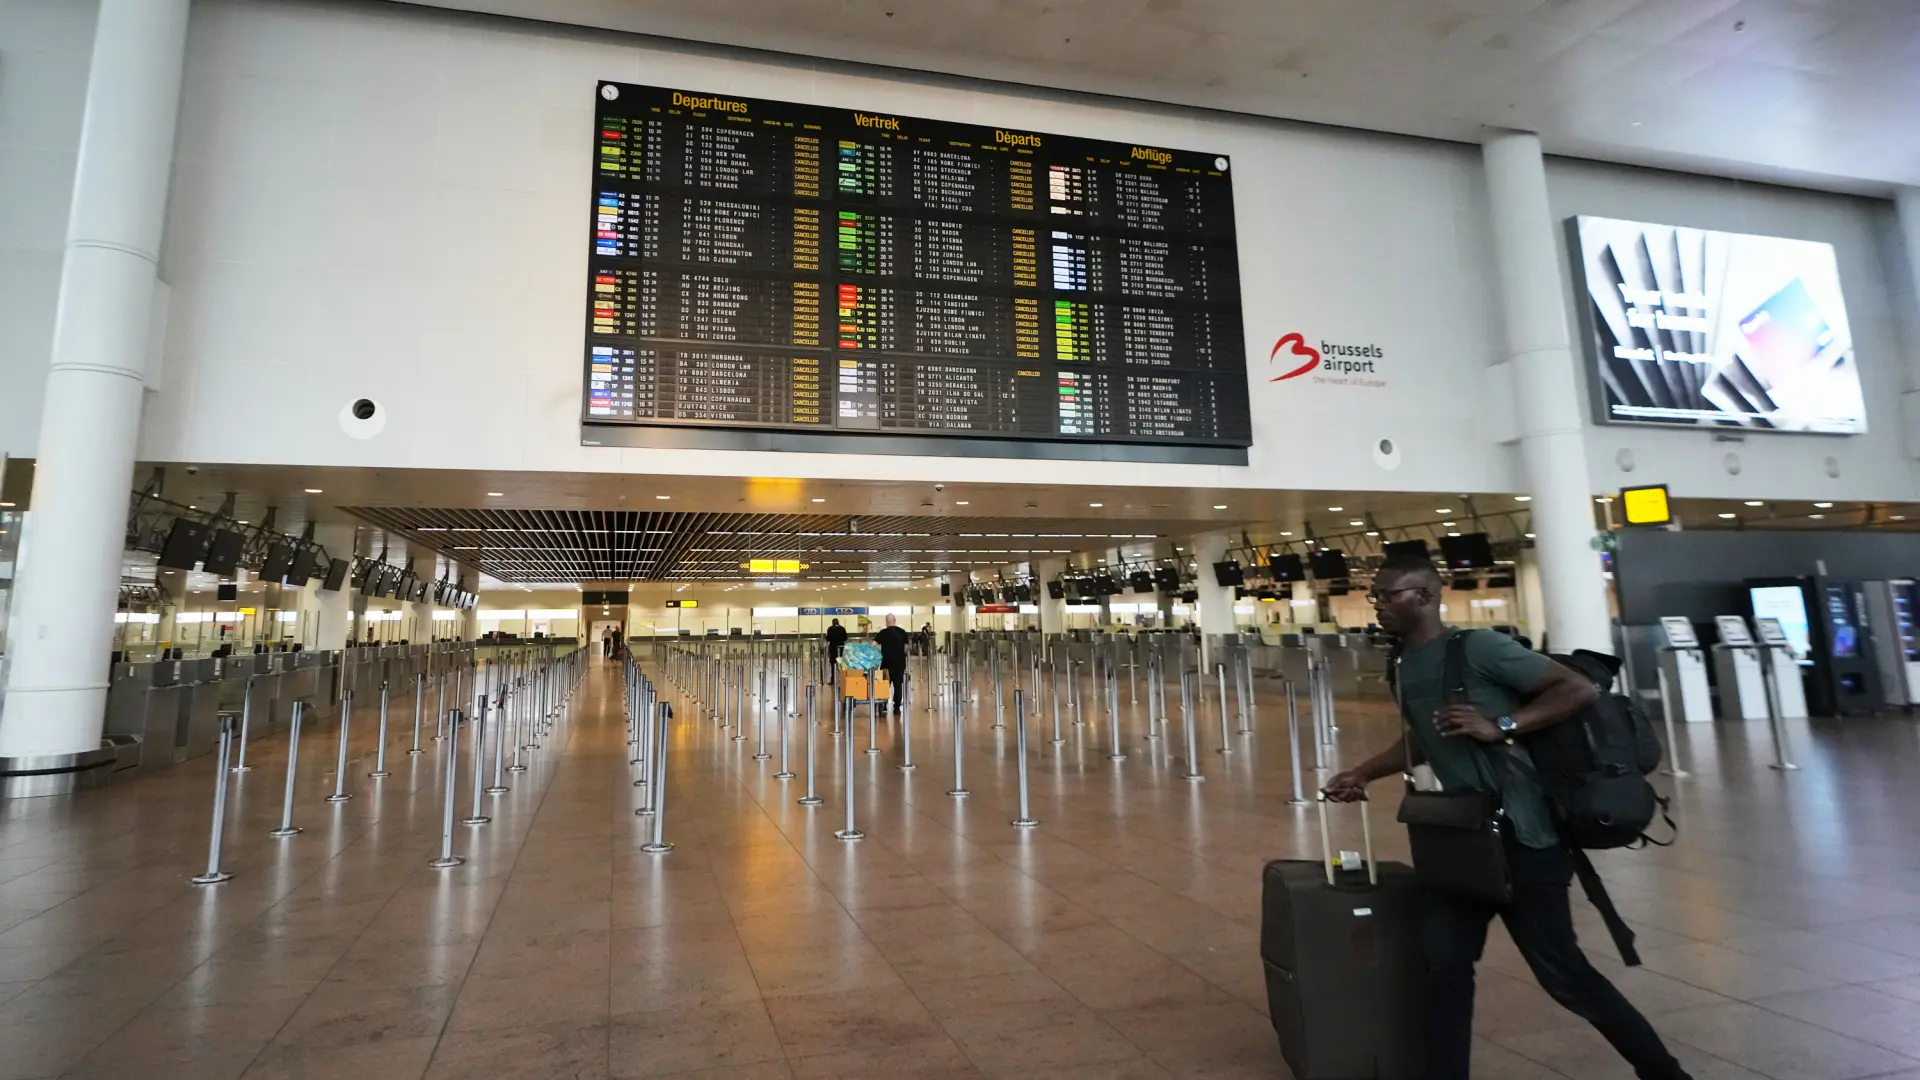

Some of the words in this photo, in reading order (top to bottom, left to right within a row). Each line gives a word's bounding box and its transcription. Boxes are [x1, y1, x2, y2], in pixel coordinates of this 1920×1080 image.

[673, 92, 748, 113] Departures
[854, 113, 900, 131] Vertrek
[716, 128, 754, 137] COPENHAGEN
[794, 136, 819, 144] CANCELLED
[995, 130, 1041, 148] Départs
[716, 135, 738, 143] DUBLIN
[794, 143, 818, 151] CANCELLED
[1131, 146, 1173, 165] Abflüge
[794, 158, 819, 166] CANCELLED
[794, 166, 819, 174] CANCELLED
[794, 173, 818, 181] CANCELLED
[794, 181, 818, 189] CANCELLED
[715, 201, 759, 210] THESSALONIKI
[714, 216, 744, 224] FLORENCE
[793, 223, 818, 231] CANCELLED
[793, 215, 818, 223] CANCELLED
[714, 224, 744, 232] HELSINKI
[714, 232, 737, 240] LISBON
[793, 238, 818, 246] CANCELLED
[714, 240, 744, 248] SHANGHAI
[793, 246, 819, 254] CANCELLED
[713, 248, 752, 256] WASHINGTON
[793, 254, 818, 262] CANCELLED
[793, 262, 818, 270] CANCELLED
[712, 284, 740, 292] BEIJING
[793, 289, 819, 297] CANCELLED
[712, 300, 739, 308] BANGKOK
[793, 305, 818, 313] CANCELLED
[712, 308, 736, 316] ATHENS
[793, 321, 818, 329] CANCELLED
[1321, 340, 1383, 358] brussels
[711, 353, 743, 361] HURGHADA
[793, 357, 818, 365] CANCELLED
[1324, 357, 1375, 374] airport
[711, 370, 746, 378] BARCELONA
[711, 378, 739, 386] ALMERIA
[793, 382, 818, 390] CANCELLED
[711, 386, 735, 394] LISBON
[793, 390, 818, 398] CANCELLED
[710, 395, 750, 403] COPENHAGEN
